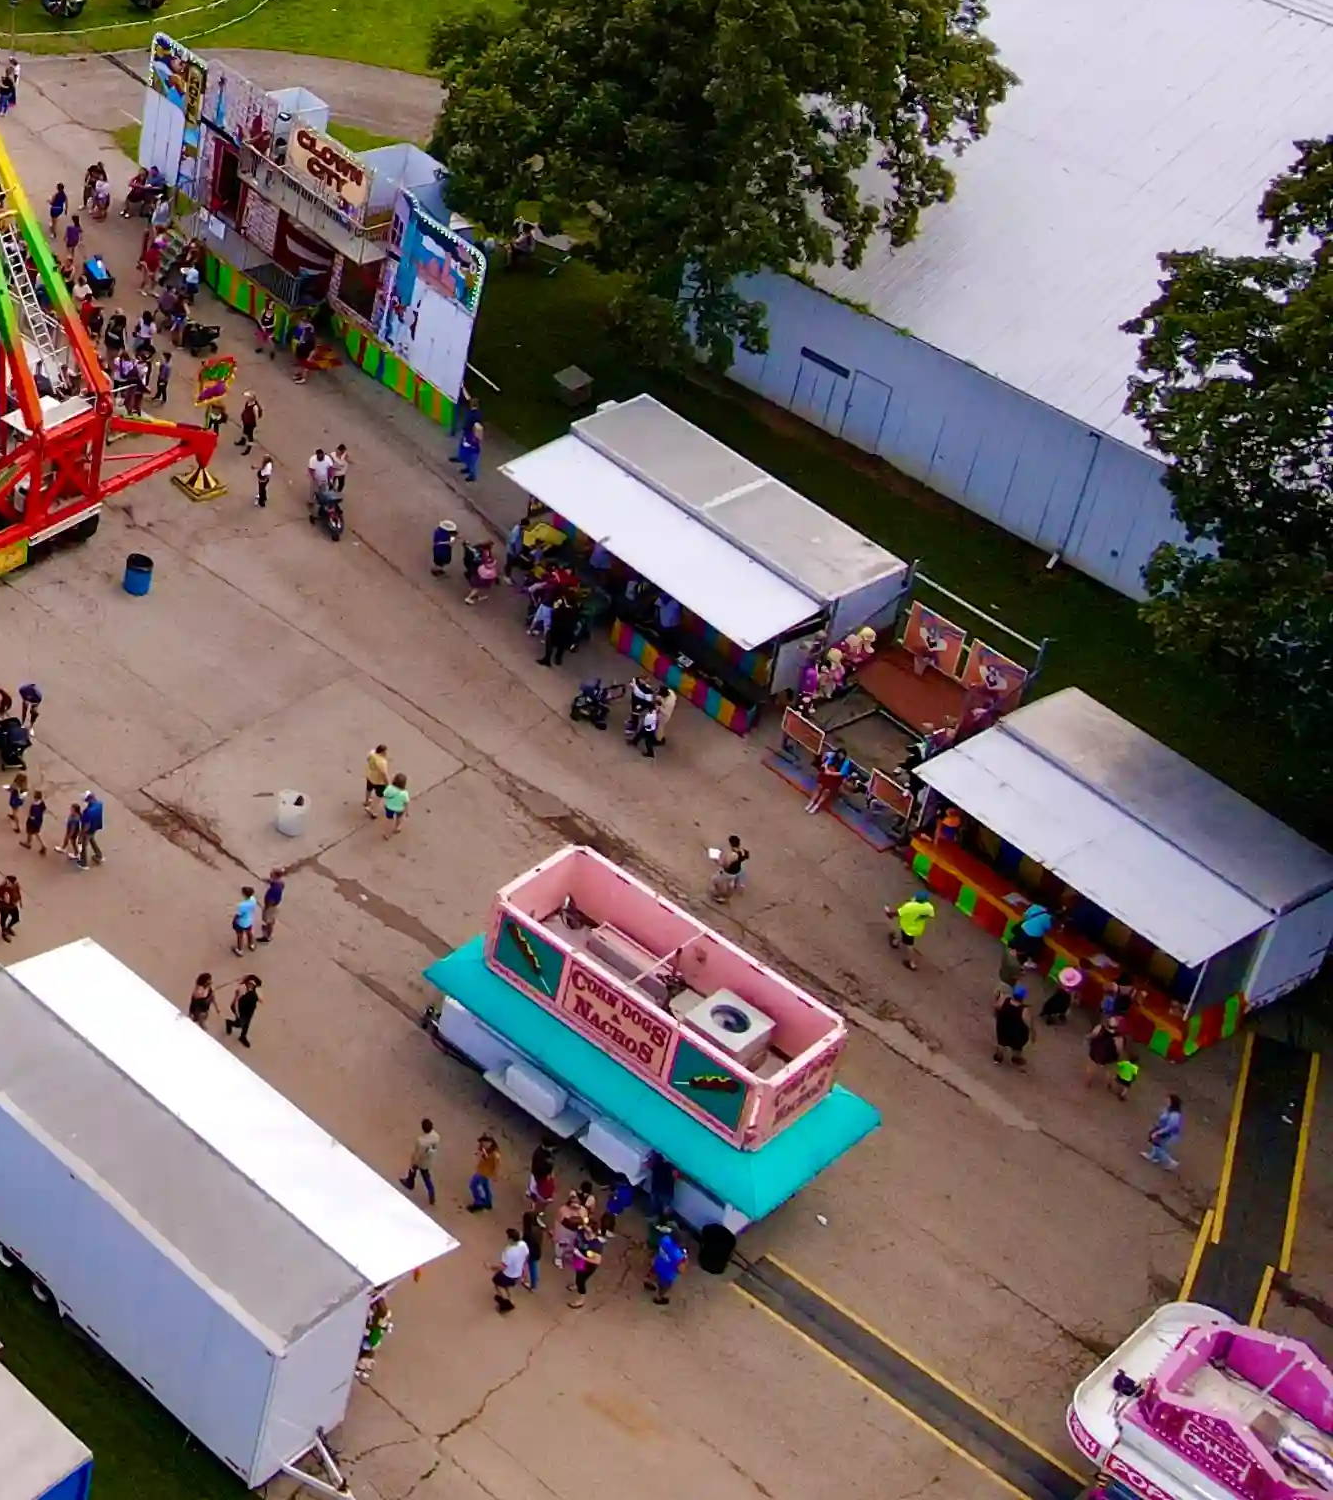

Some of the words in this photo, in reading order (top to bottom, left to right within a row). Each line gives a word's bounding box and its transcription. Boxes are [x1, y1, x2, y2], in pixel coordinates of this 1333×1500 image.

[297, 130, 364, 186] CLOWN
[307, 157, 349, 193] CITY
[572, 970, 618, 1008] CORN
[621, 1000, 667, 1048] DOGS
[573, 993, 654, 1064] NACHOS
